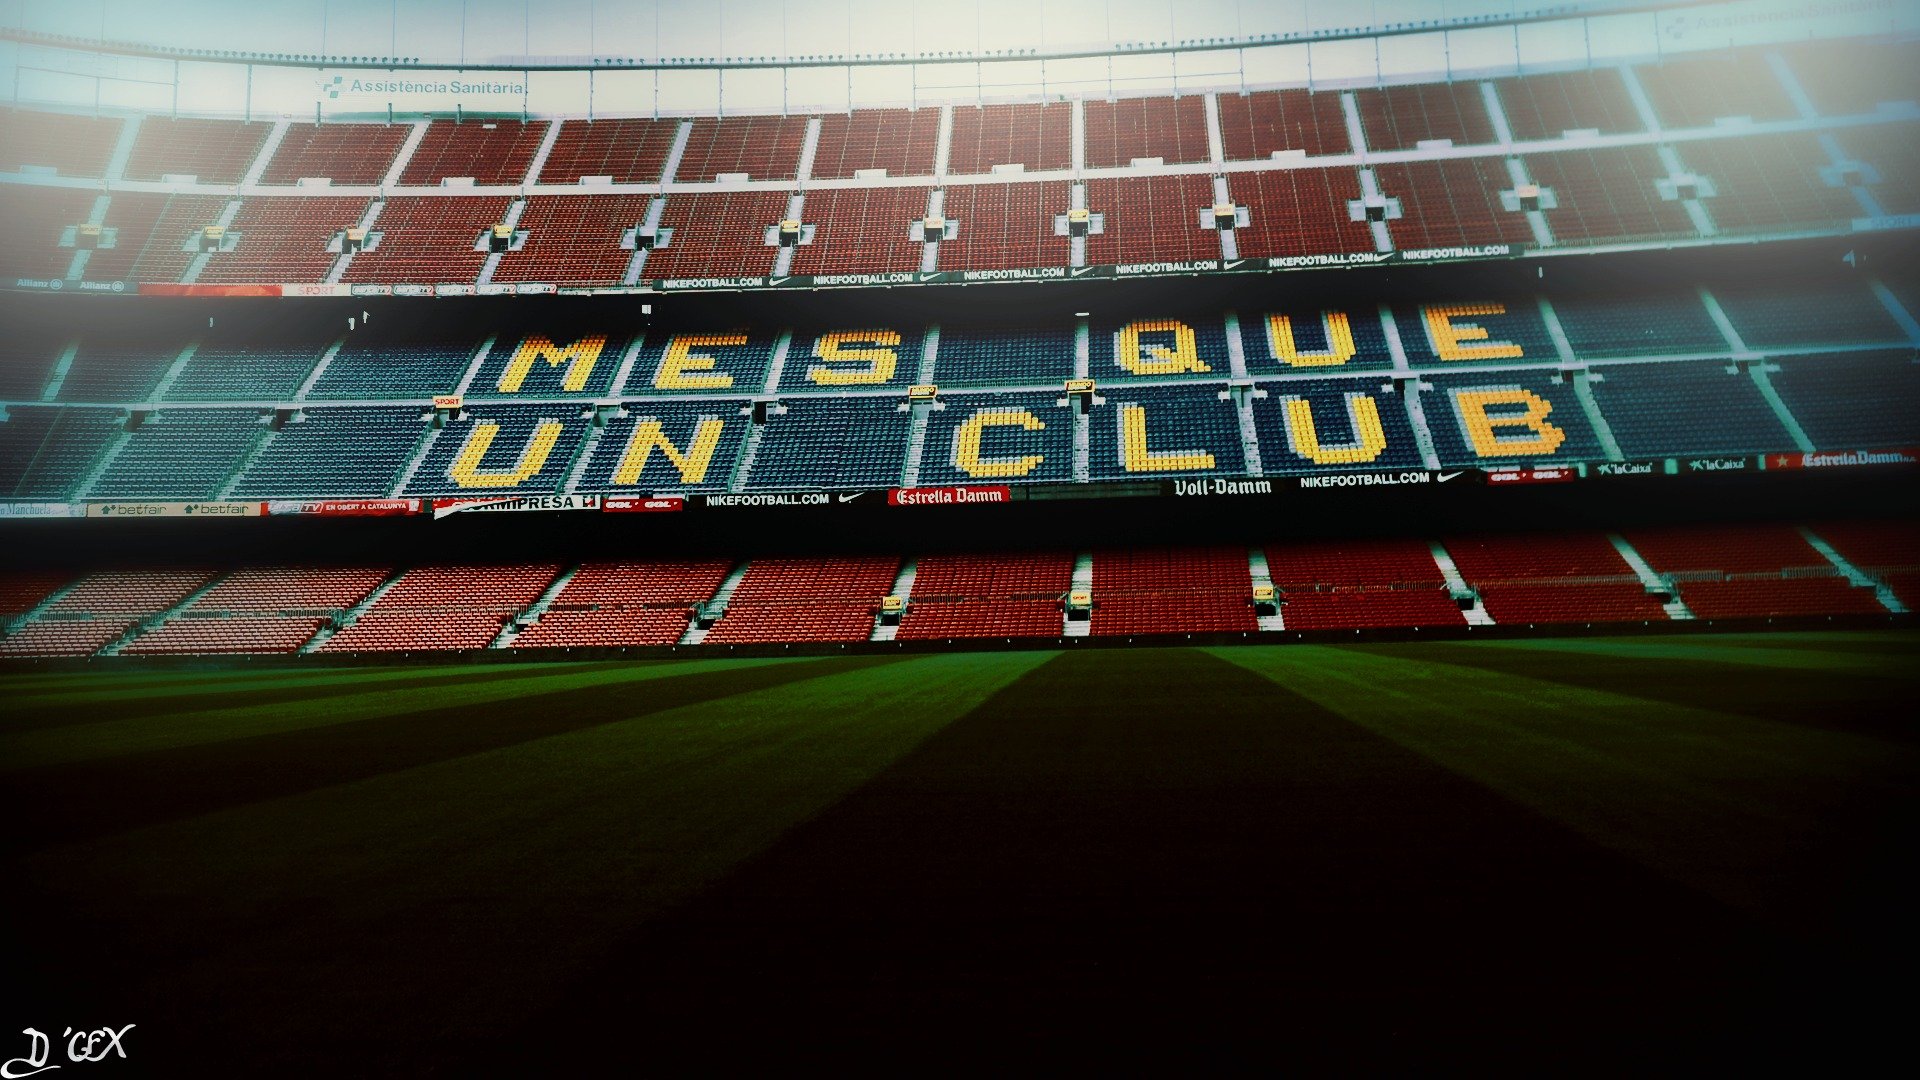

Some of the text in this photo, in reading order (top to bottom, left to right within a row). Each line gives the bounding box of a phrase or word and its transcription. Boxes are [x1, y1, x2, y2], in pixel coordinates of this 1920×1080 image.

[351, 79, 523, 94] Assistència Sanitària
[1269, 252, 1374, 267] NIKEFOOTBALL.COM
[1403, 245, 1509, 260] NIKEFOOTBALL.COM
[964, 267, 1065, 280] NIKEFOOTBALL.COM
[1116, 260, 1218, 274] NIKEFOOTBALL.COM
[17, 278, 48, 288] Allianz
[80, 281, 112, 290] Allianz
[663, 277, 762, 289] NIKEFOOTBALL.COM
[814, 273, 913, 285] NIKEFOOTBALL.COM
[298, 286, 335, 295] SPORT
[1115, 303, 1523, 376] QUE
[435, 397, 461, 406] SPORT
[448, 387, 1566, 488] UN CLUB
[1802, 453, 1857, 467] Estrella
[1857, 450, 1902, 465] Damm
[1300, 472, 1430, 488] NIKEFOOTBALL.COM
[1174, 479, 1272, 497] Voll-Damm
[706, 493, 829, 507] NIKEFOOTBALL.COM
[896, 487, 1003, 504] Estrella Damm
[118, 504, 167, 514] betfair
[201, 502, 248, 514] betfair
[304, 502, 321, 512] TV
[326, 501, 336, 510] EN
[338, 501, 360, 510] OBERT
[361, 501, 366, 509] A
[367, 500, 407, 510] CATALUNYA
